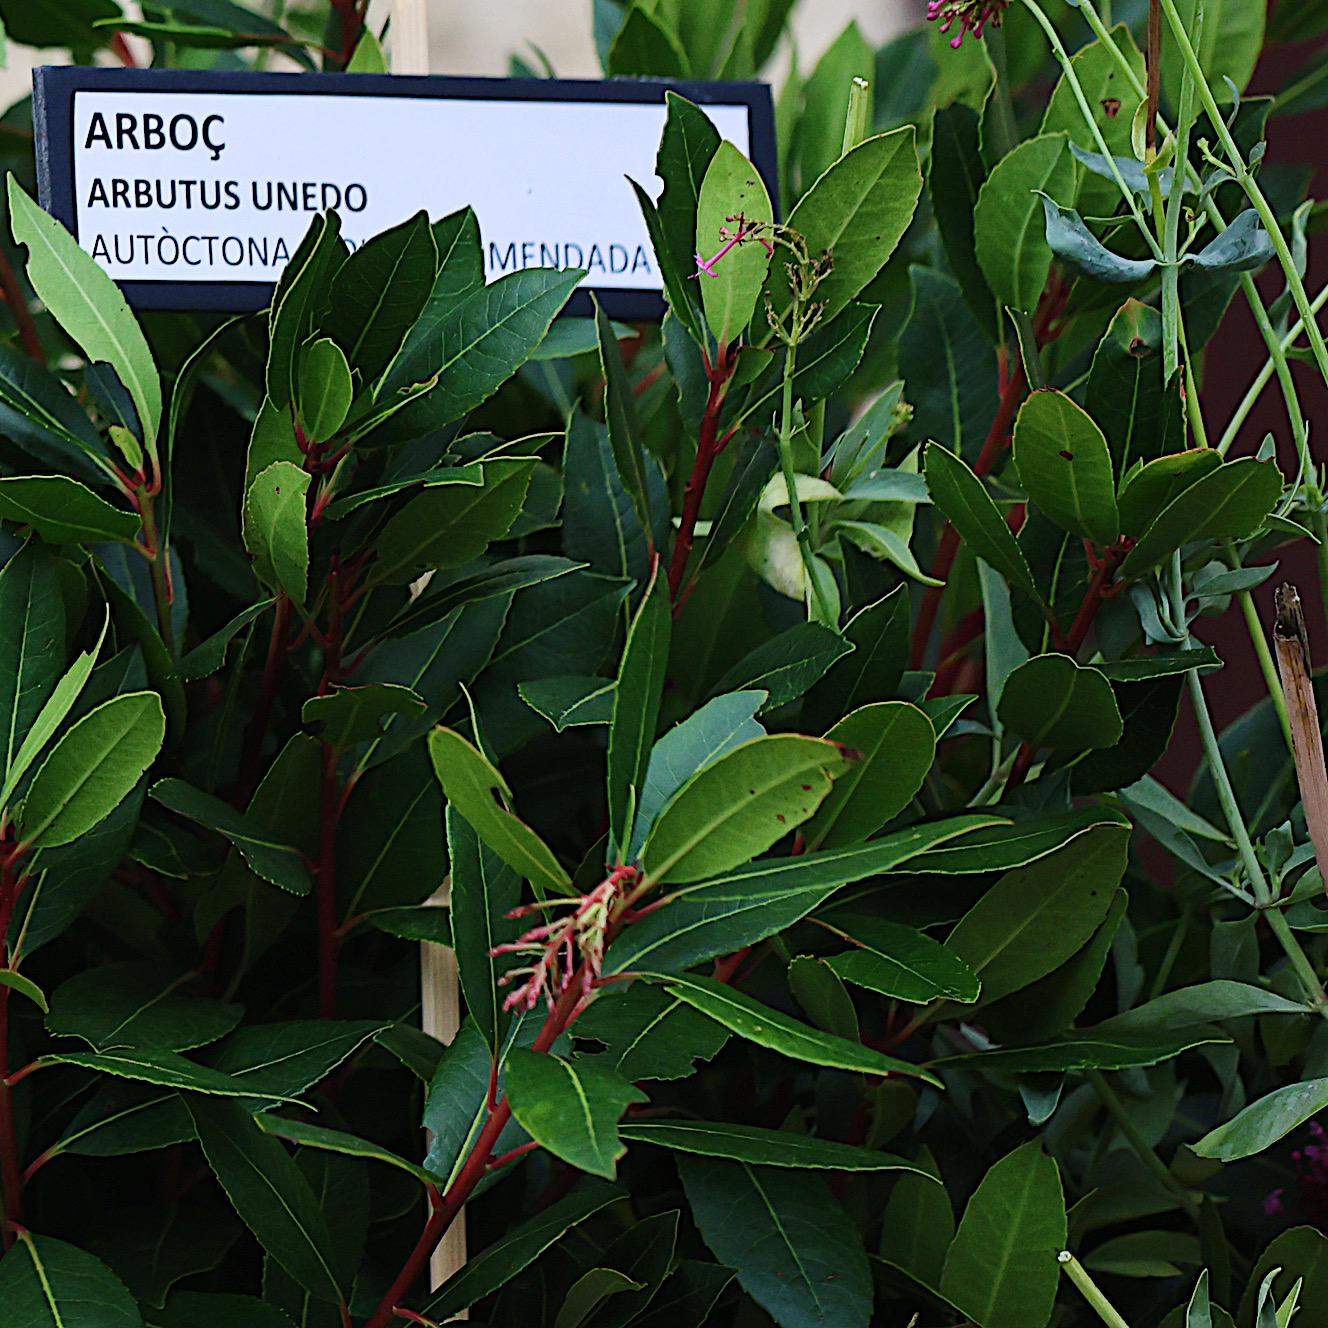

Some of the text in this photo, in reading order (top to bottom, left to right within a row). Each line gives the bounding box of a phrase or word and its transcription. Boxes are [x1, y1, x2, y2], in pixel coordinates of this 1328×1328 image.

[84, 112, 226, 161] ARBOÇ
[87, 178, 369, 213] ARBUTUS UNEDO
[91, 226, 291, 268] AUTÒCTONA
